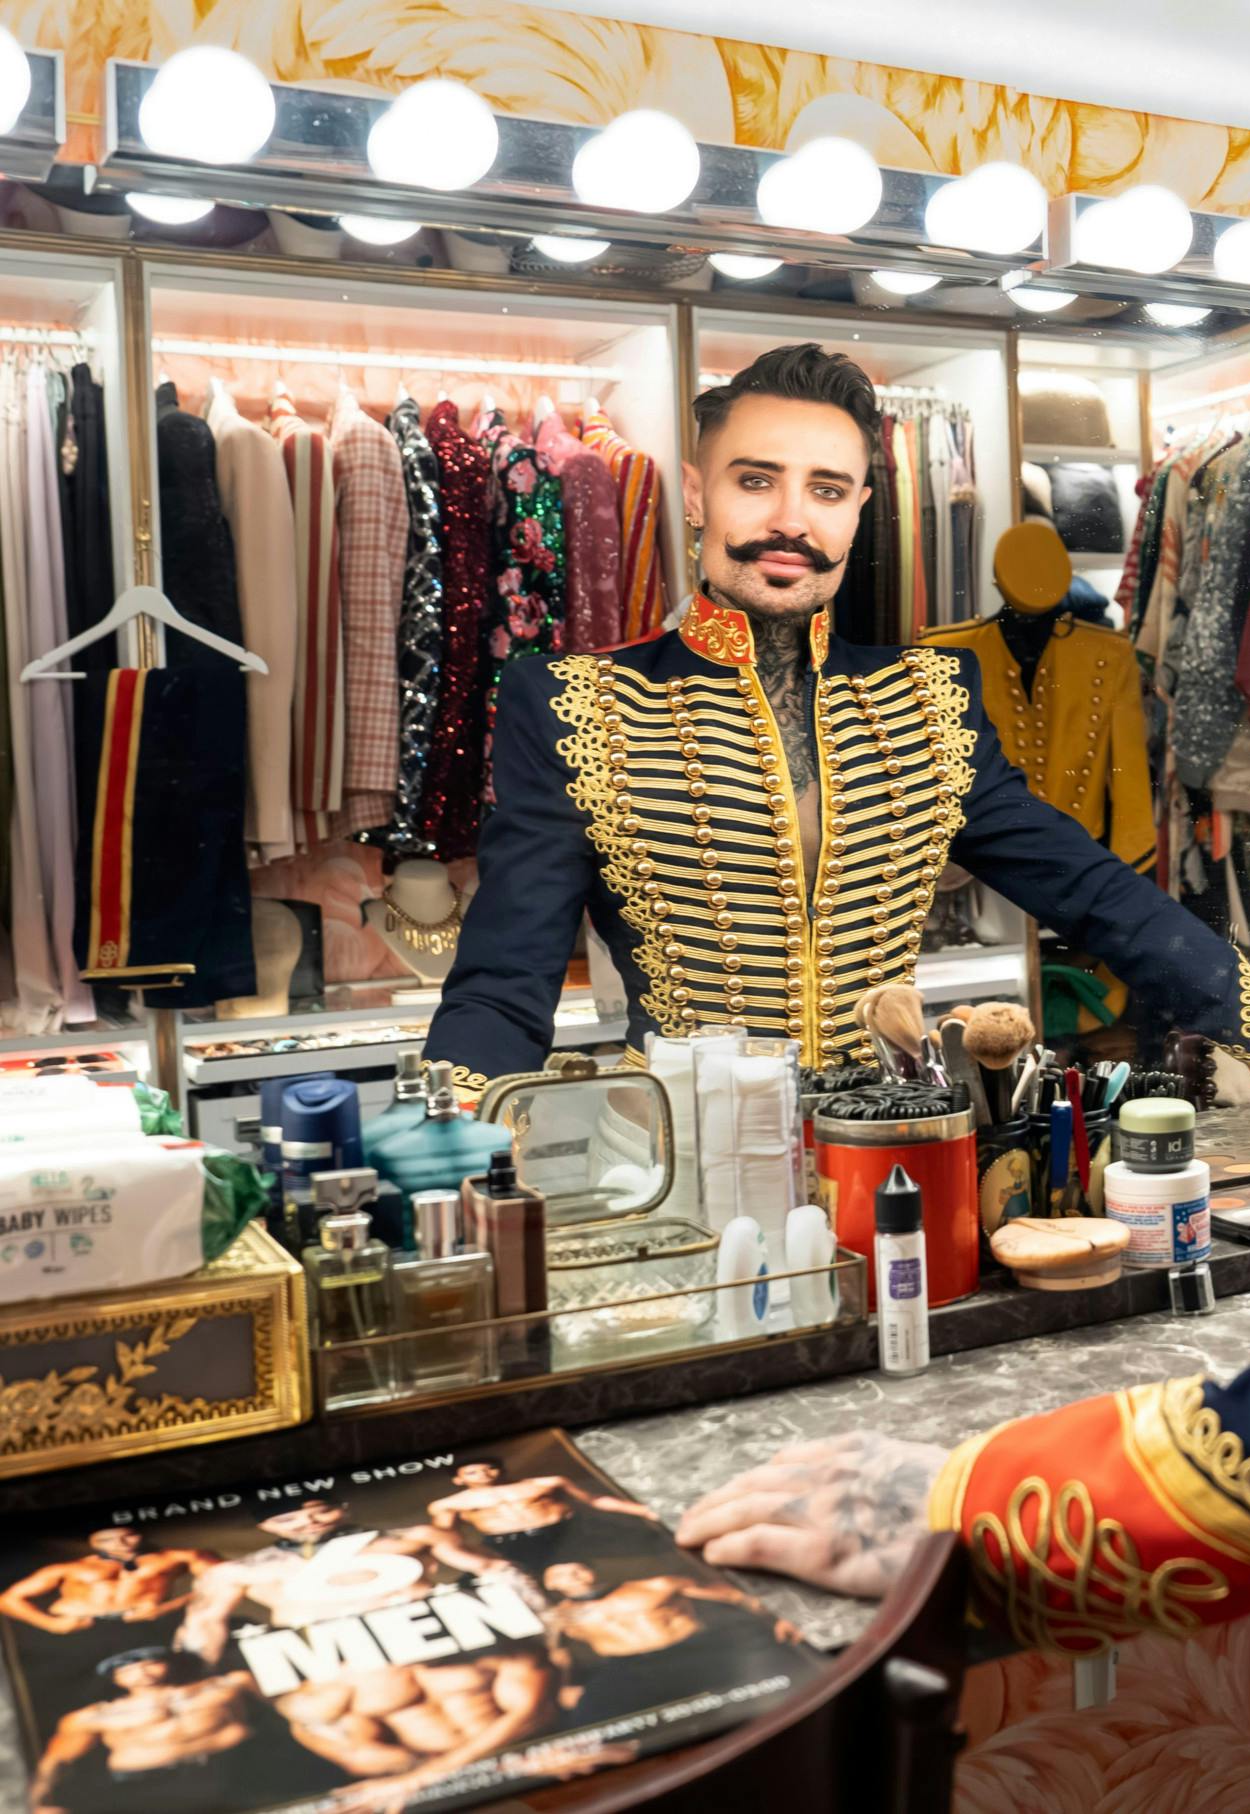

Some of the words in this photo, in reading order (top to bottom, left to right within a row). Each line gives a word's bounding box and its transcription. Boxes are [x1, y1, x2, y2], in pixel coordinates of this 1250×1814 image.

[54, 1203, 112, 1227] WIPES
[113, 1493, 241, 1524] BRAND
[257, 1477, 335, 1501] NEW
[351, 1453, 455, 1484] SHOW
[285, 1530, 424, 1604] 6
[238, 1582, 546, 1698] MEN
